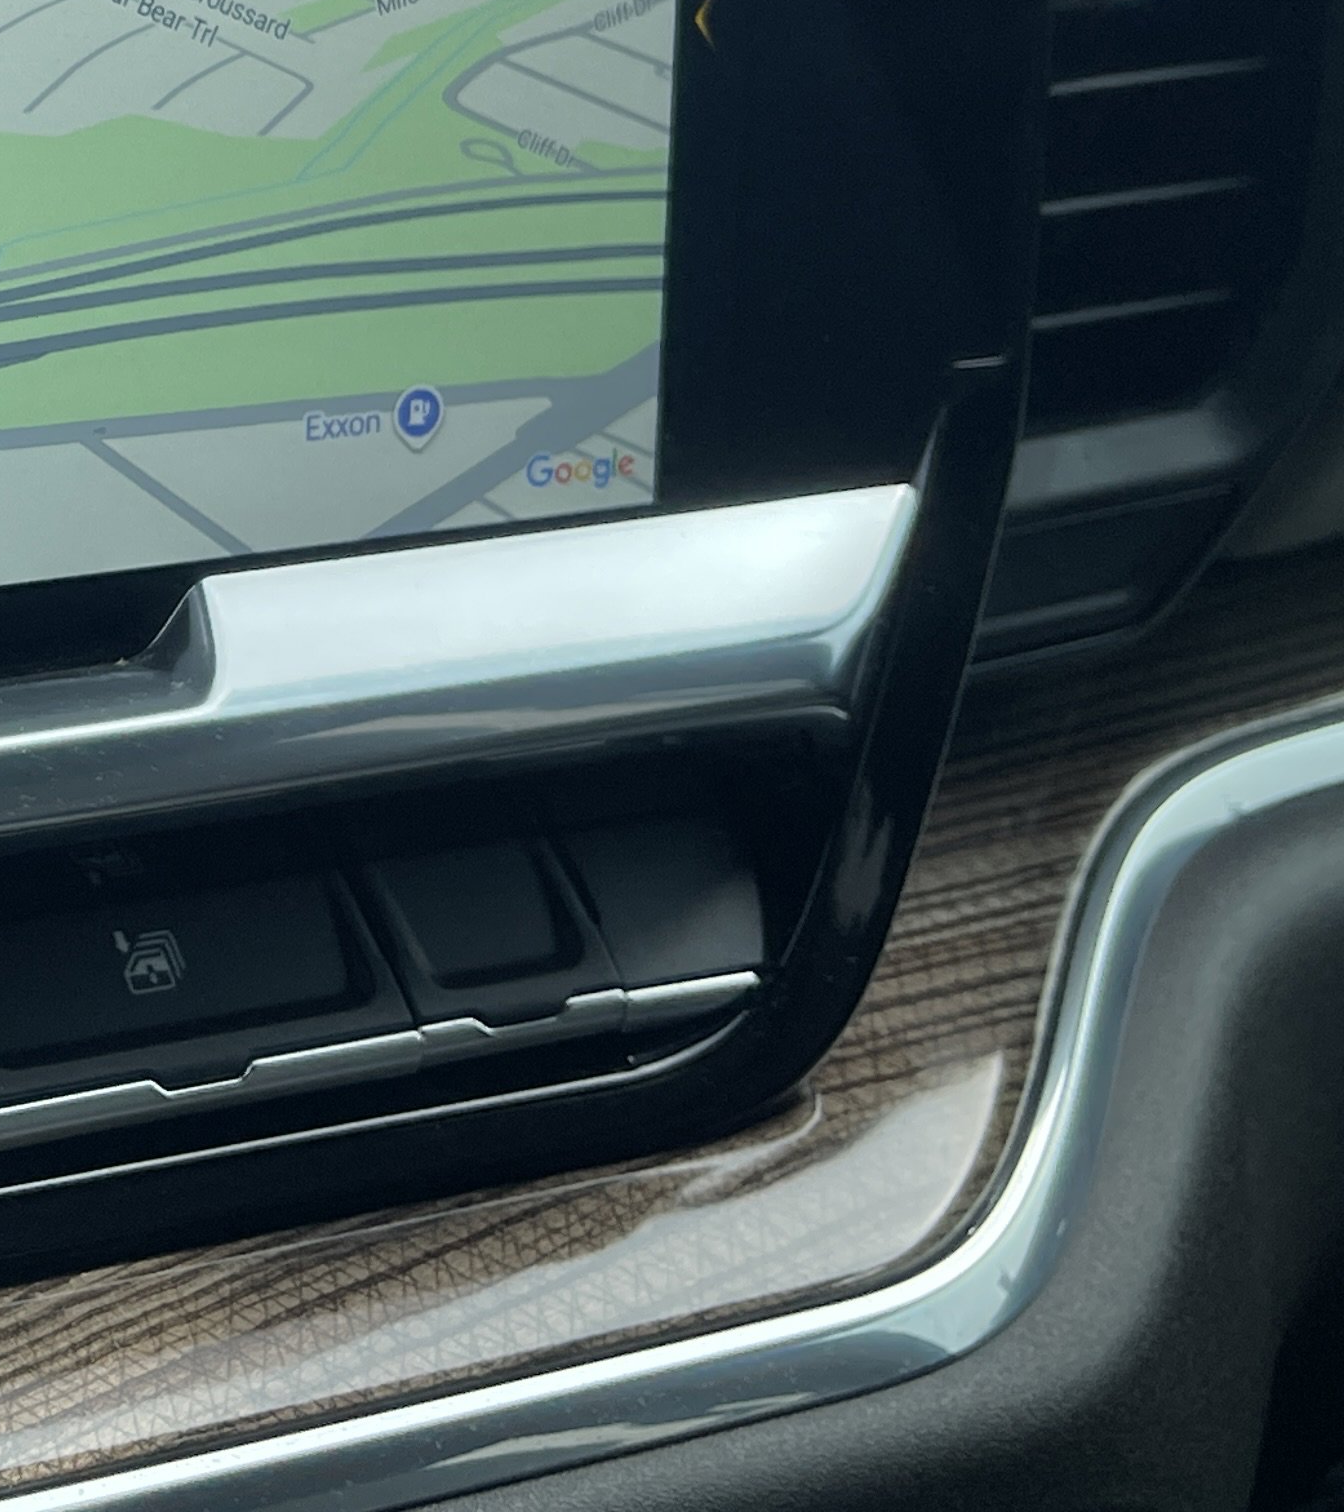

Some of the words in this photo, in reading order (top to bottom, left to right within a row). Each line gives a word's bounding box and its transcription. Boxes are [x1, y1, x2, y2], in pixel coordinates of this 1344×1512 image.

[190, 16, 220, 48] Trl
[593, 4, 632, 33] Cliff
[516, 128, 554, 159] Cliff
[554, 144, 576, 168] Dr
[305, 411, 381, 443] Exxon
[526, 446, 636, 488] Google
